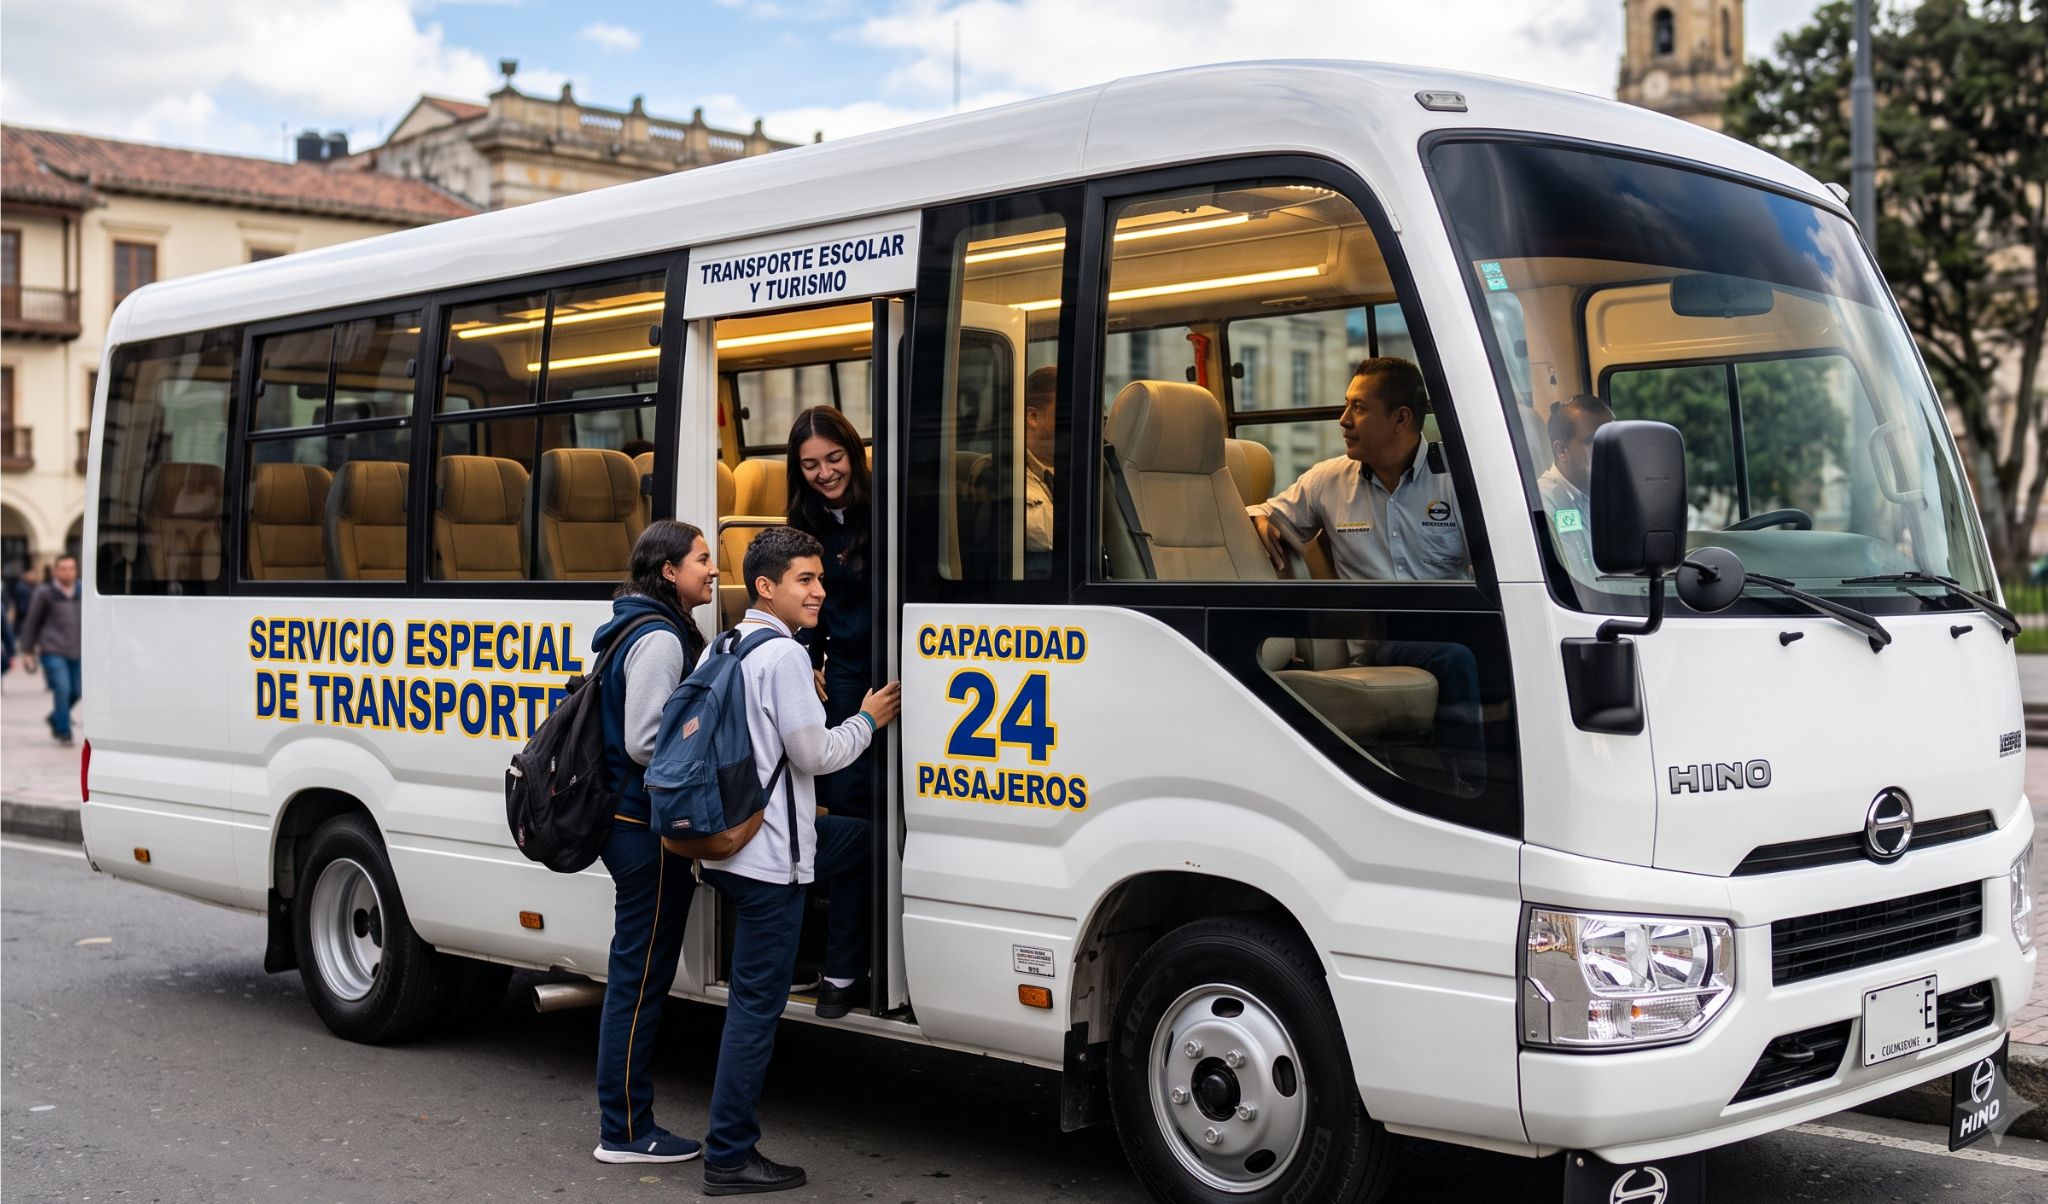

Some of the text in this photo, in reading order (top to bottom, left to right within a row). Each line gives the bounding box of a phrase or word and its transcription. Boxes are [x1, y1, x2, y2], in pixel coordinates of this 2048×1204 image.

[701, 233, 905, 285] TRANSPORTE ESCOLAR
[750, 269, 847, 302] Y TURISMO
[249, 617, 584, 672] SERVICIO ESPECIAL
[918, 626, 1087, 661] CAPACIDAD
[256, 671, 299, 719] DE
[947, 670, 1055, 762] 24
[918, 765, 1087, 809] PASAJEROS
[1668, 758, 1772, 795] HINO
[1960, 1098, 2000, 1138] HINO
